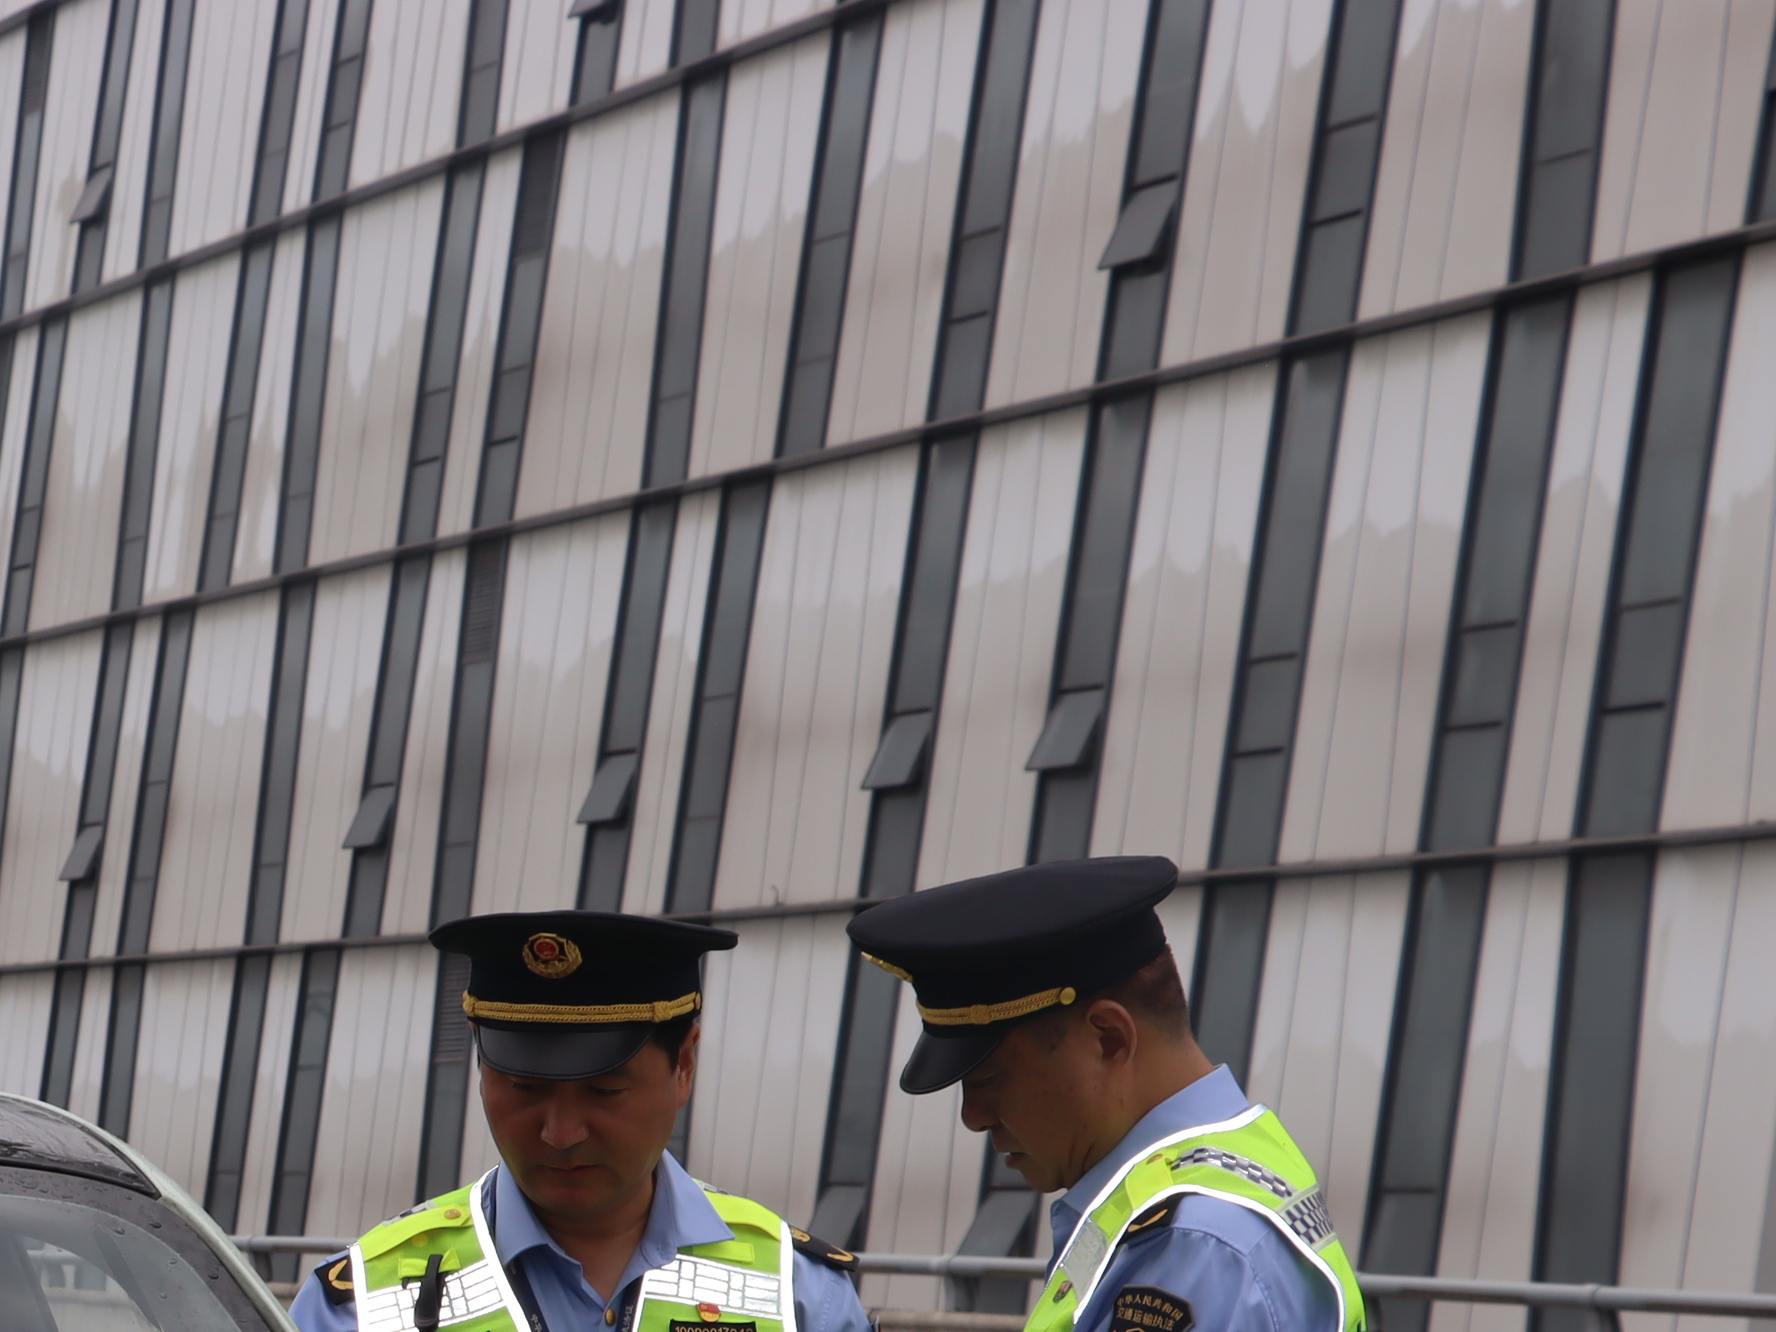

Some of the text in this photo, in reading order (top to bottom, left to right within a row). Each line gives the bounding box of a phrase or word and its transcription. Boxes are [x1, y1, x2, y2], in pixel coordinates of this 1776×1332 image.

[1115, 1307, 1176, 1332] 交通运输执法
[1116, 1293, 1184, 1322] 中华人民共和国
